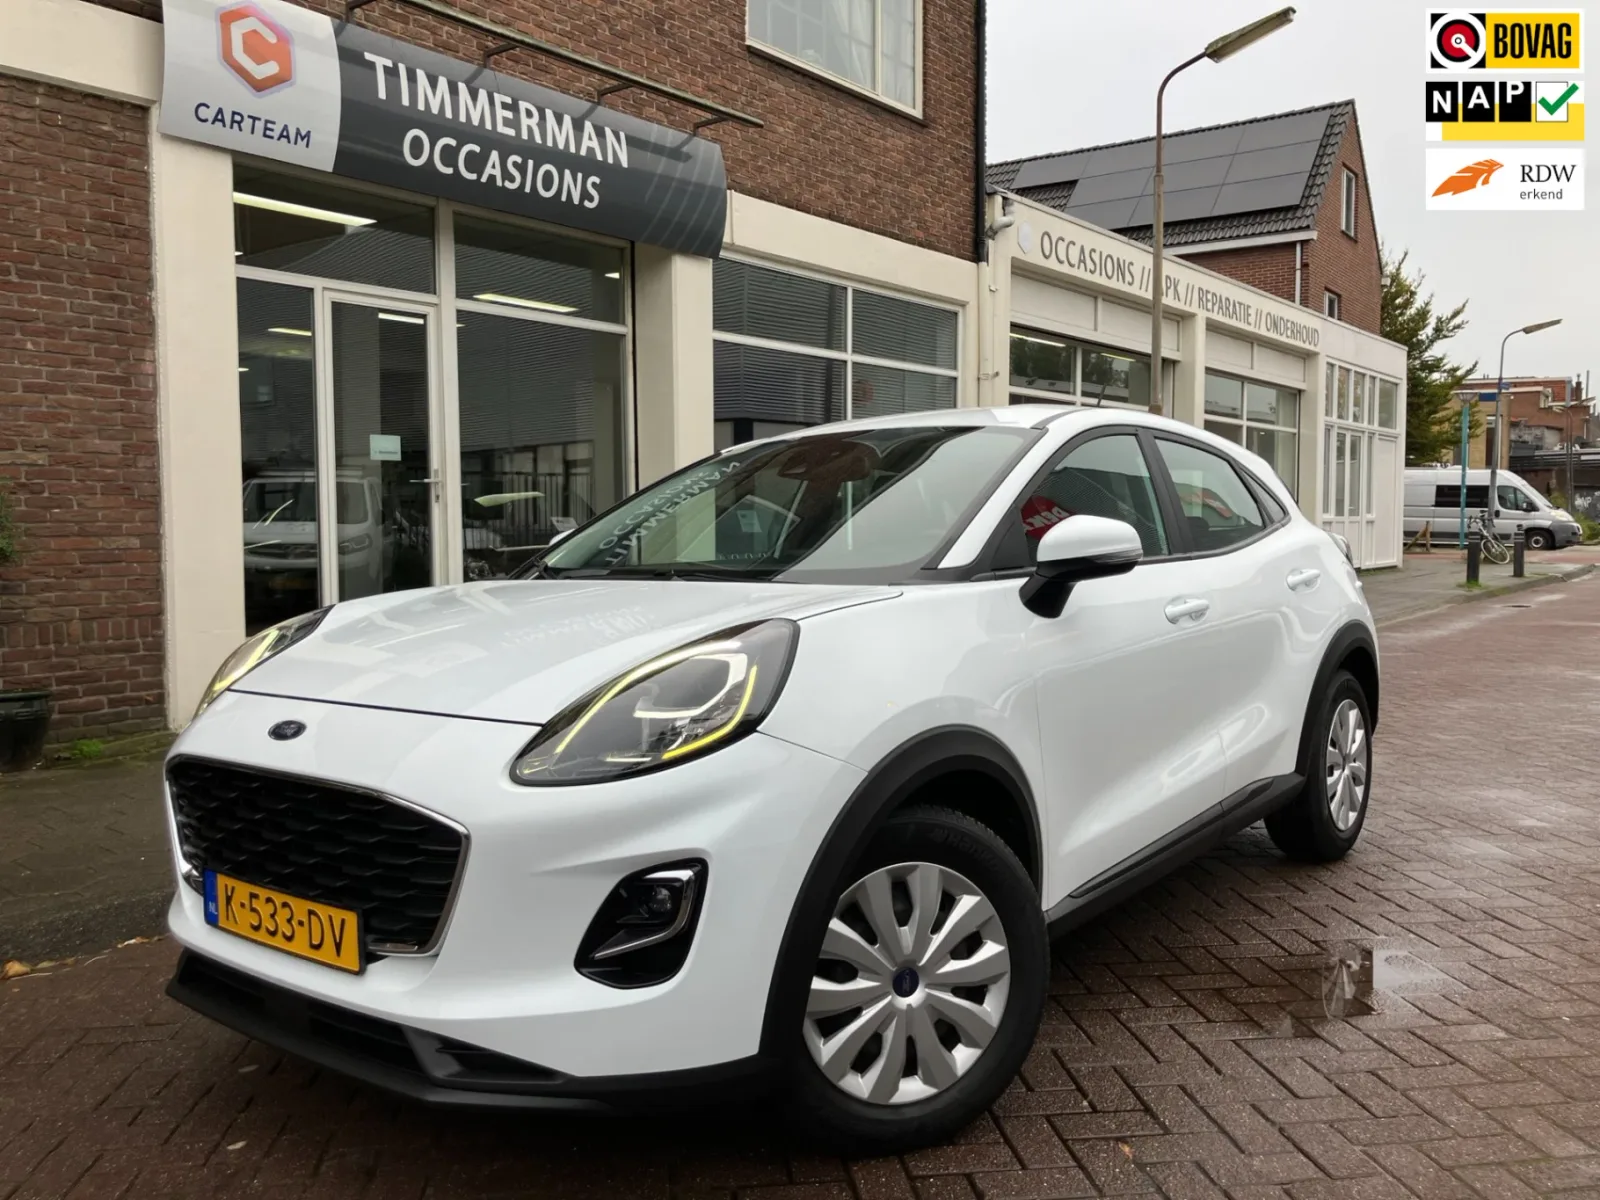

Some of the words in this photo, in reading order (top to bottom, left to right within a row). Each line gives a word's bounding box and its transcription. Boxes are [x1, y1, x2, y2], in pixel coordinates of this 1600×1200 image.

[194, 102, 311, 148] CARTEAM
[363, 52, 628, 168] TIMMERMAN
[403, 128, 601, 209] OCCASIONS
[1040, 231, 1135, 286] OCCASIONS
[1198, 287, 1252, 326] REPARATIE
[1265, 312, 1320, 347] ONDERHOUD
[208, 901, 218, 915] NL
[225, 883, 346, 957] K-533-DV
